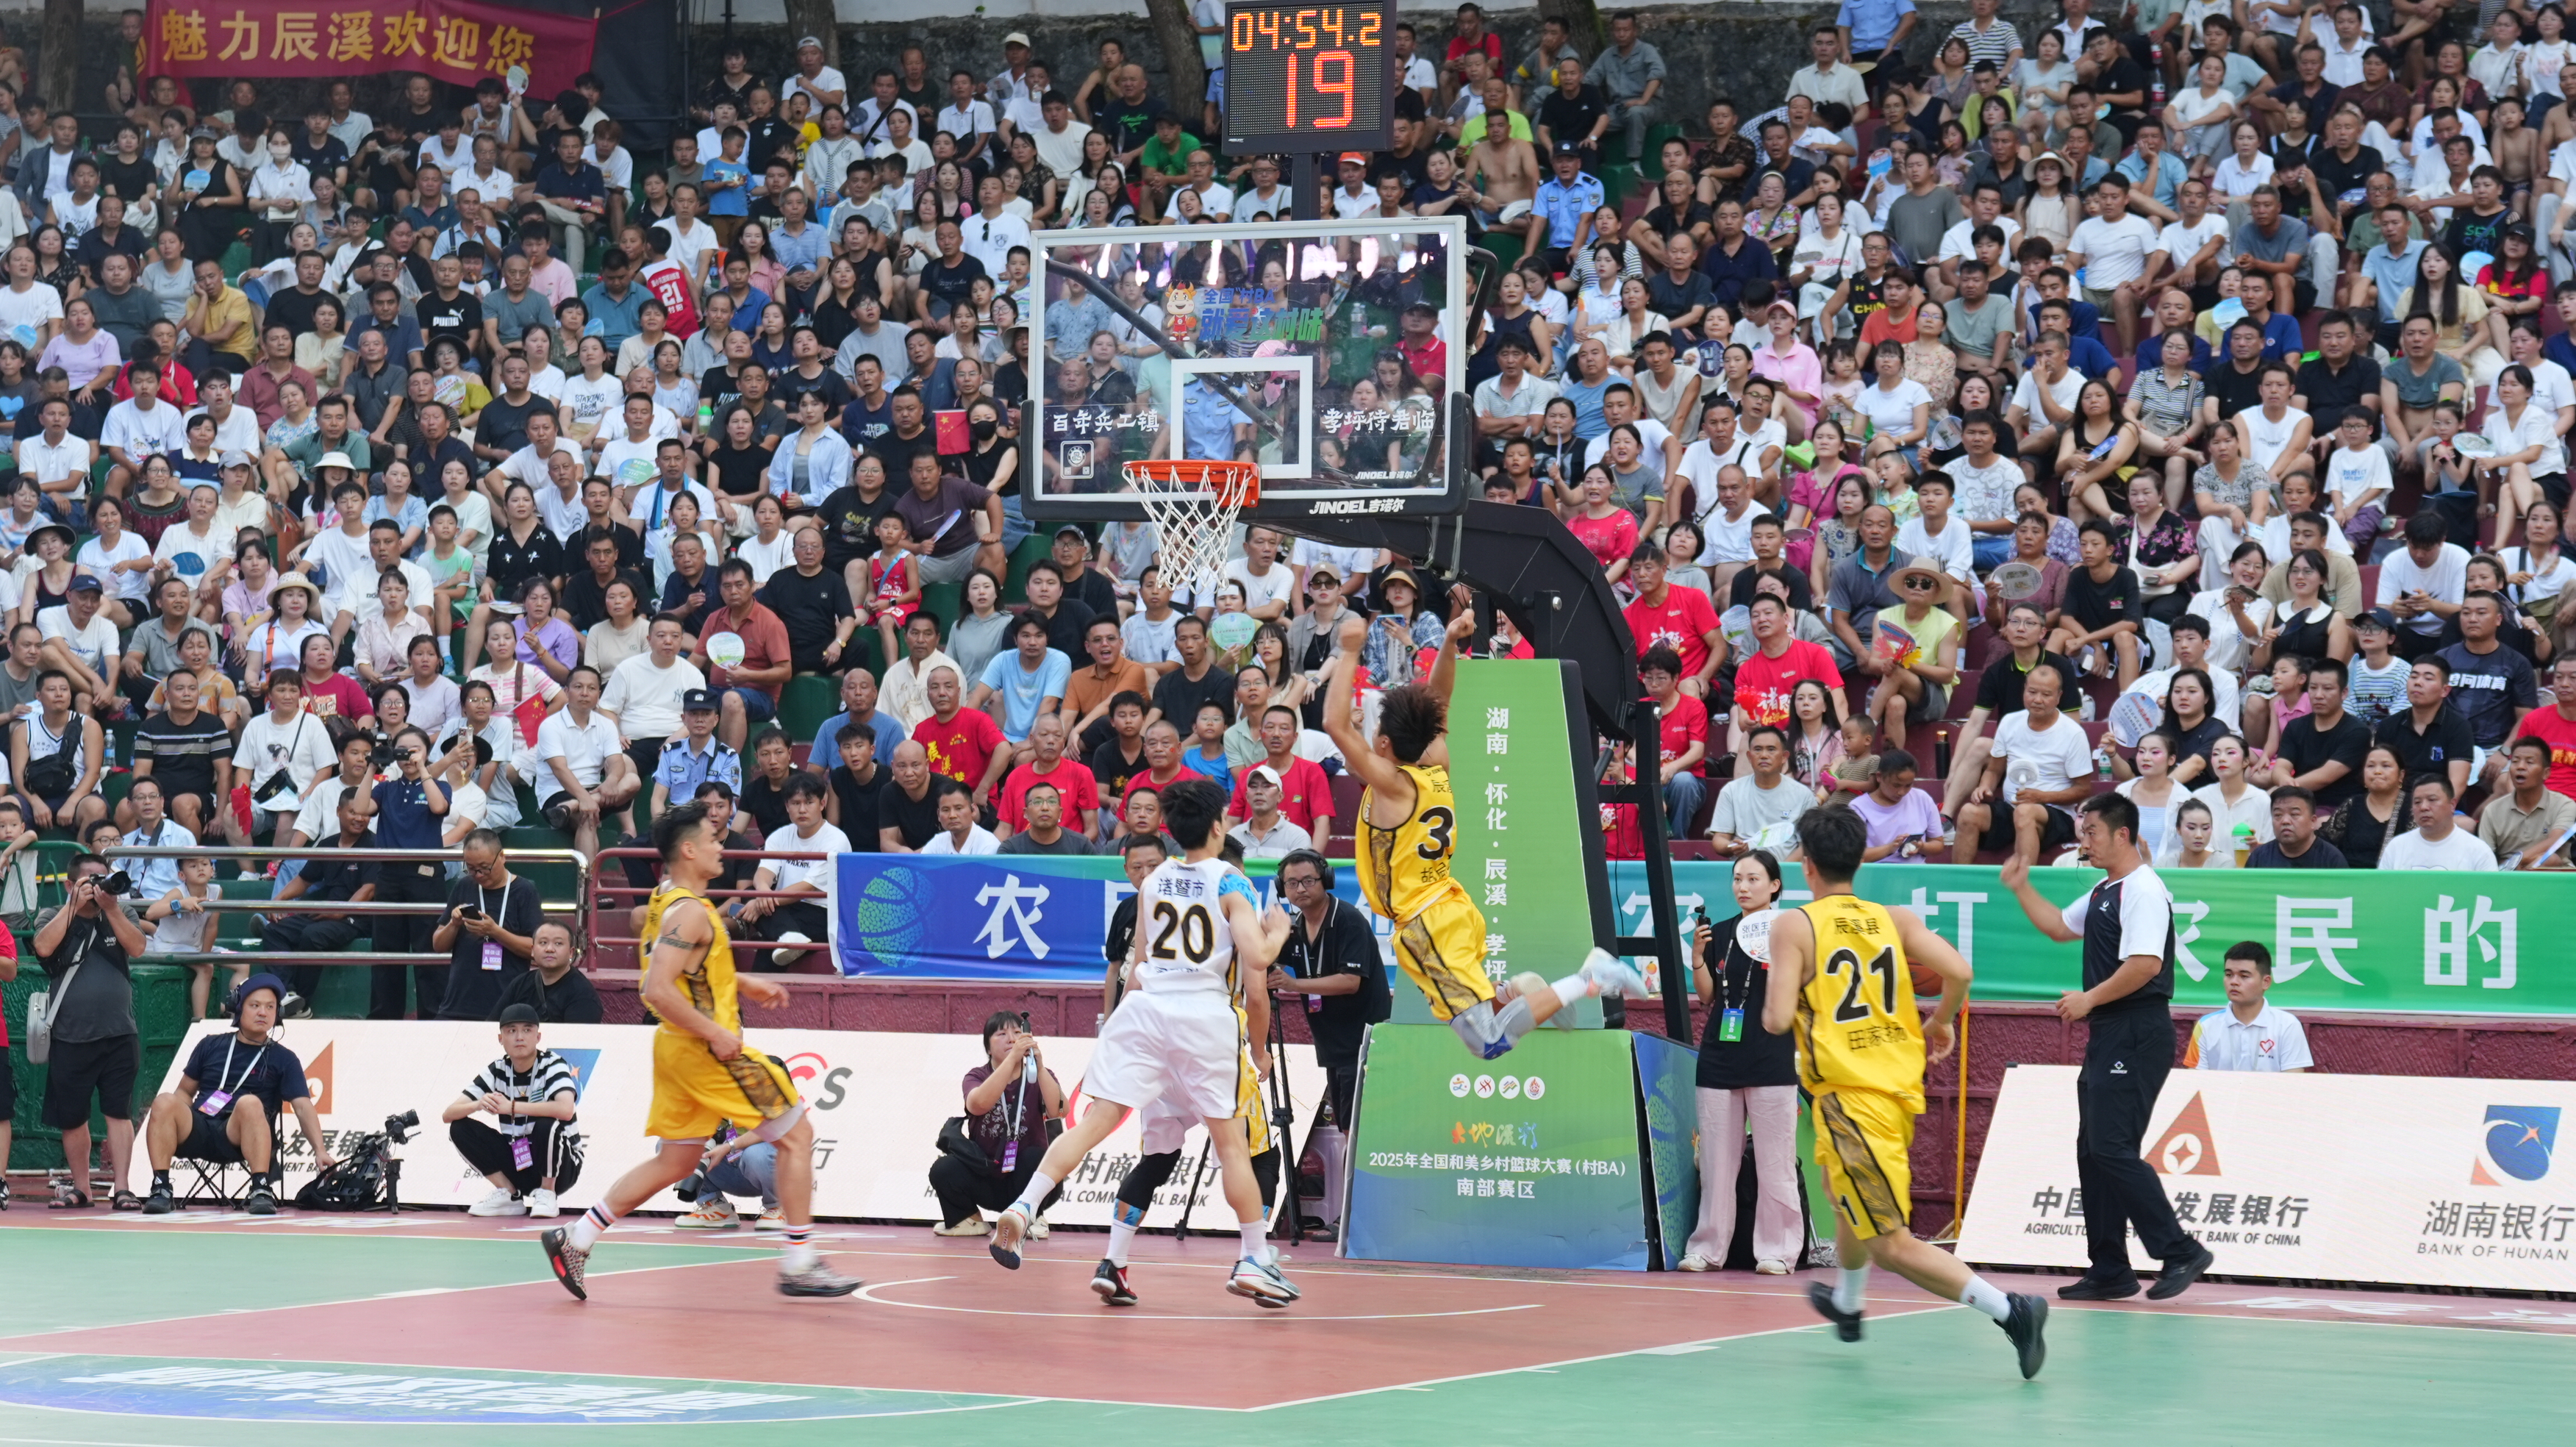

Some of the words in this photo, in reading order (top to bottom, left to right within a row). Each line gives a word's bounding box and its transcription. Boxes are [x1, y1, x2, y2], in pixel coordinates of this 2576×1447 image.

[161, 9, 535, 76] 魅力辰溪欢迎您
[1232, 10, 1381, 51] 04:54.2
[1286, 51, 1353, 128] 19
[659, 281, 684, 307] 21
[1853, 302, 1886, 314] CHIN
[432, 316, 460, 327] PUMA
[1198, 307, 1324, 341] 就爱这村味
[575, 393, 605, 403] STARTING
[581, 401, 597, 410] FROM
[1053, 409, 1160, 435] 百年兵工镇
[1321, 407, 1437, 434] 孝坪待君临
[1157, 877, 1204, 898] 诸暨市
[1151, 901, 1214, 964] 20
[1742, 921, 1776, 935] 张医生
[1833, 918, 1881, 935] 辰溪县
[1824, 944, 1898, 1023] 21
[1456, 1176, 1535, 1199] 南部赛区
[2032, 1186, 2309, 1229] 中国发展银行
[2024, 1223, 2088, 1237] AGRICULTU
[2206, 1230, 2240, 1244] BANK
[2244, 1233, 2261, 1245] OF
[2264, 1234, 2301, 1246] CHINA
[2422, 1200, 2575, 1243] 湖南银行
[2416, 1243, 2464, 1257] BANK
[2472, 1244, 2497, 1257] OF
[2504, 1246, 2570, 1261] HUNAN
